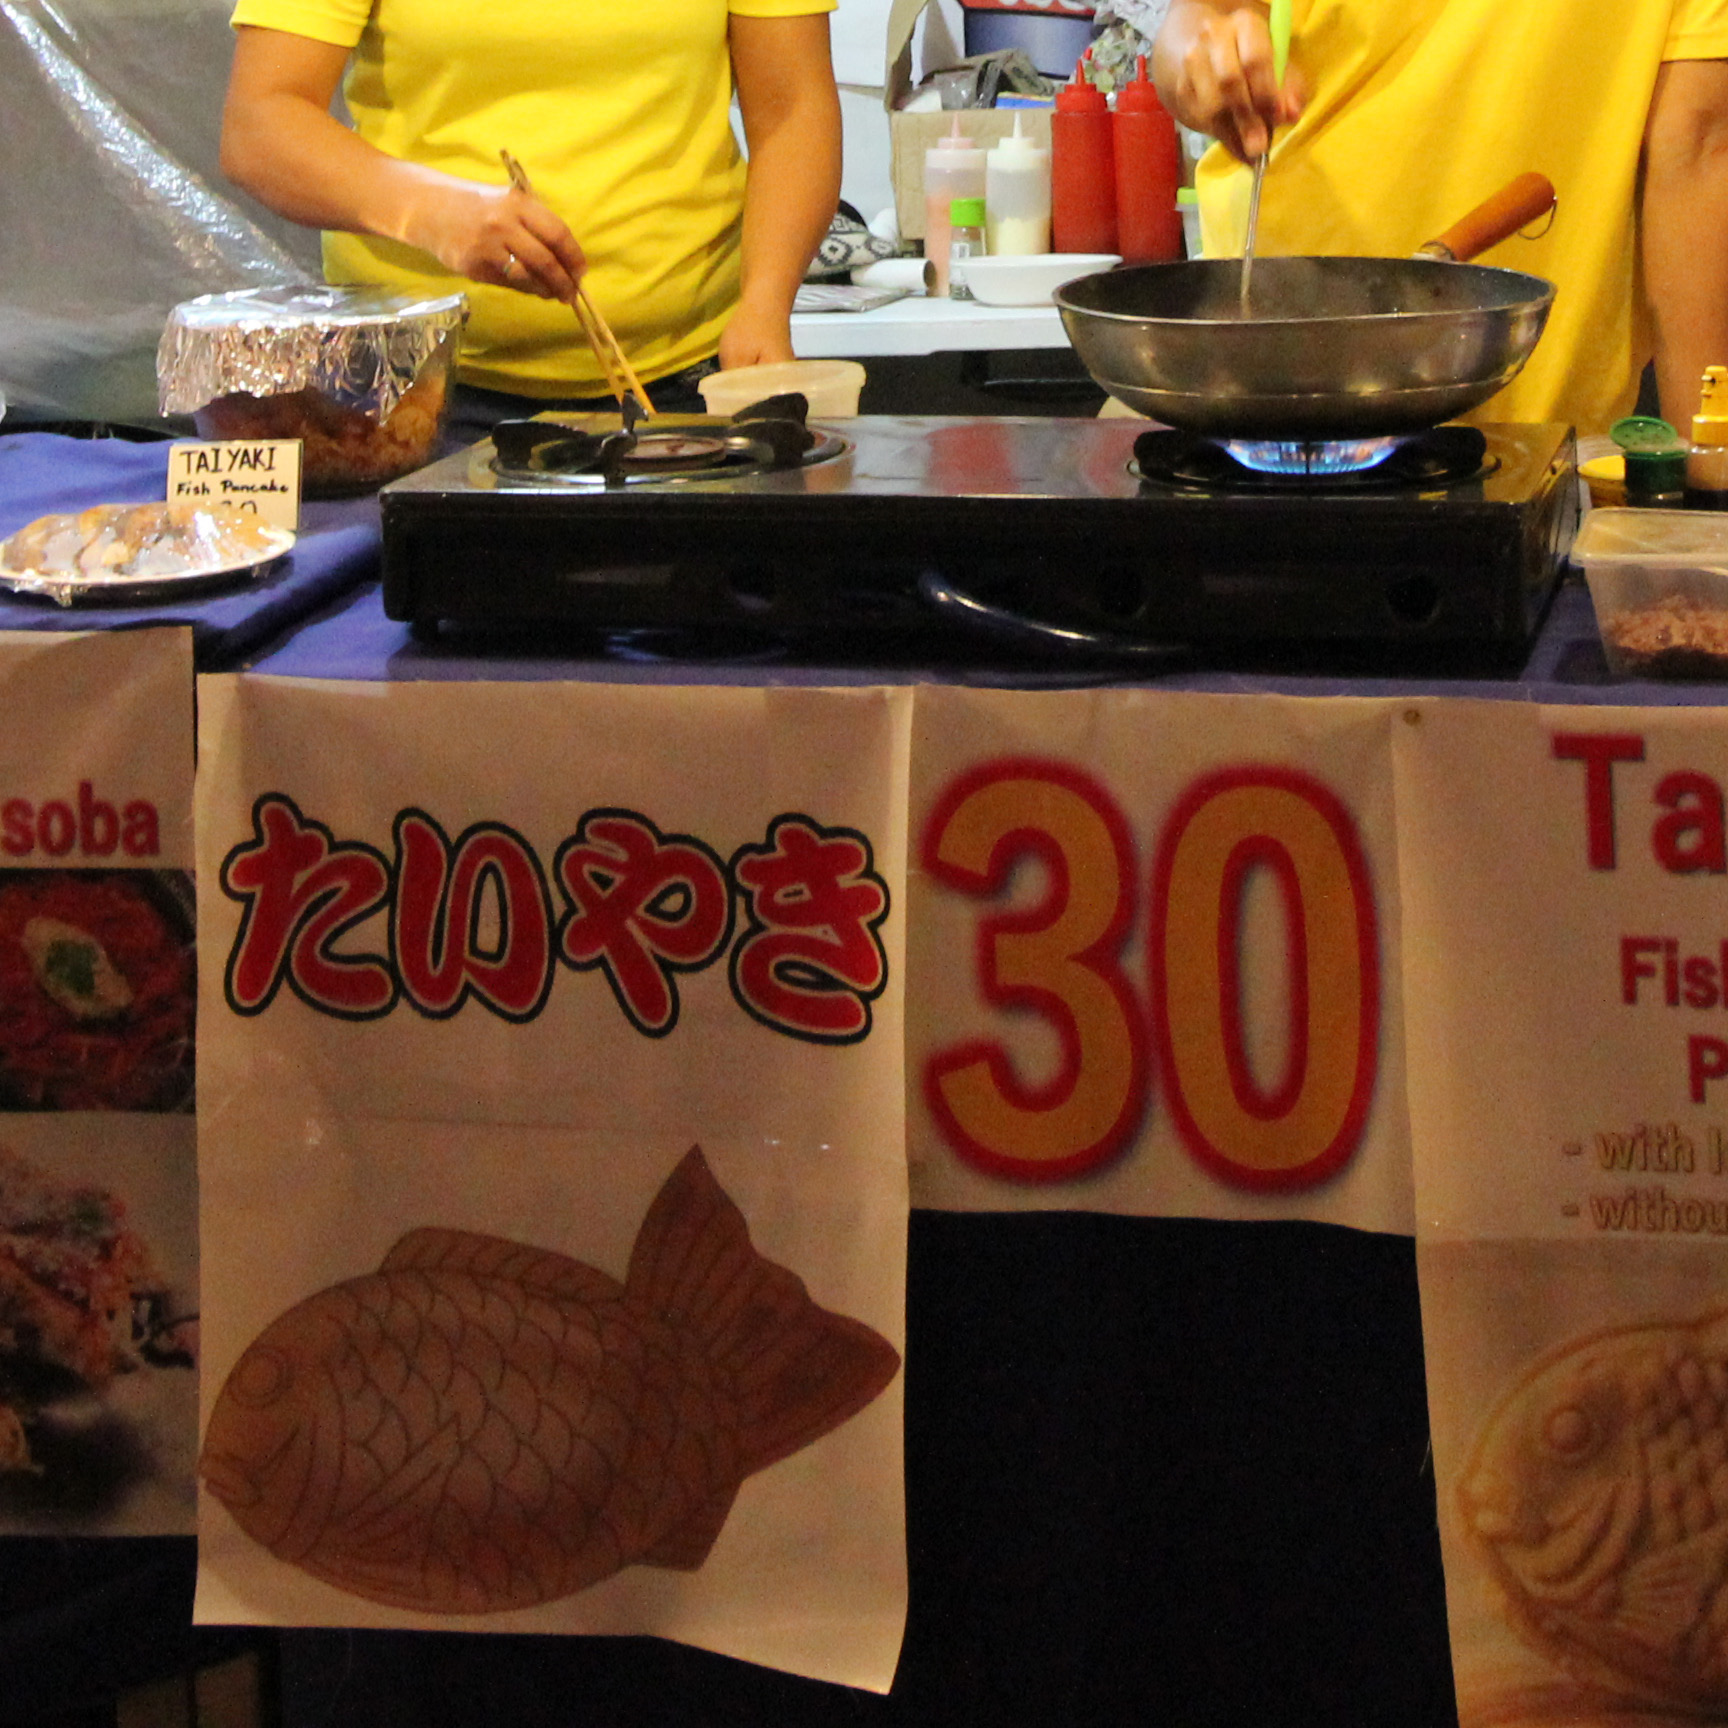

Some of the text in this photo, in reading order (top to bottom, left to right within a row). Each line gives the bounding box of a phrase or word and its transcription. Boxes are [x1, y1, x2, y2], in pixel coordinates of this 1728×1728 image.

[176, 478, 288, 496] Fish Pancake
[180, 447, 276, 474] TAIYAKI
[0, 779, 160, 858] soba
[221, 792, 890, 1045] たいやき
[920, 756, 1380, 1196] 30
[1593, 1123, 1696, 1173] with
